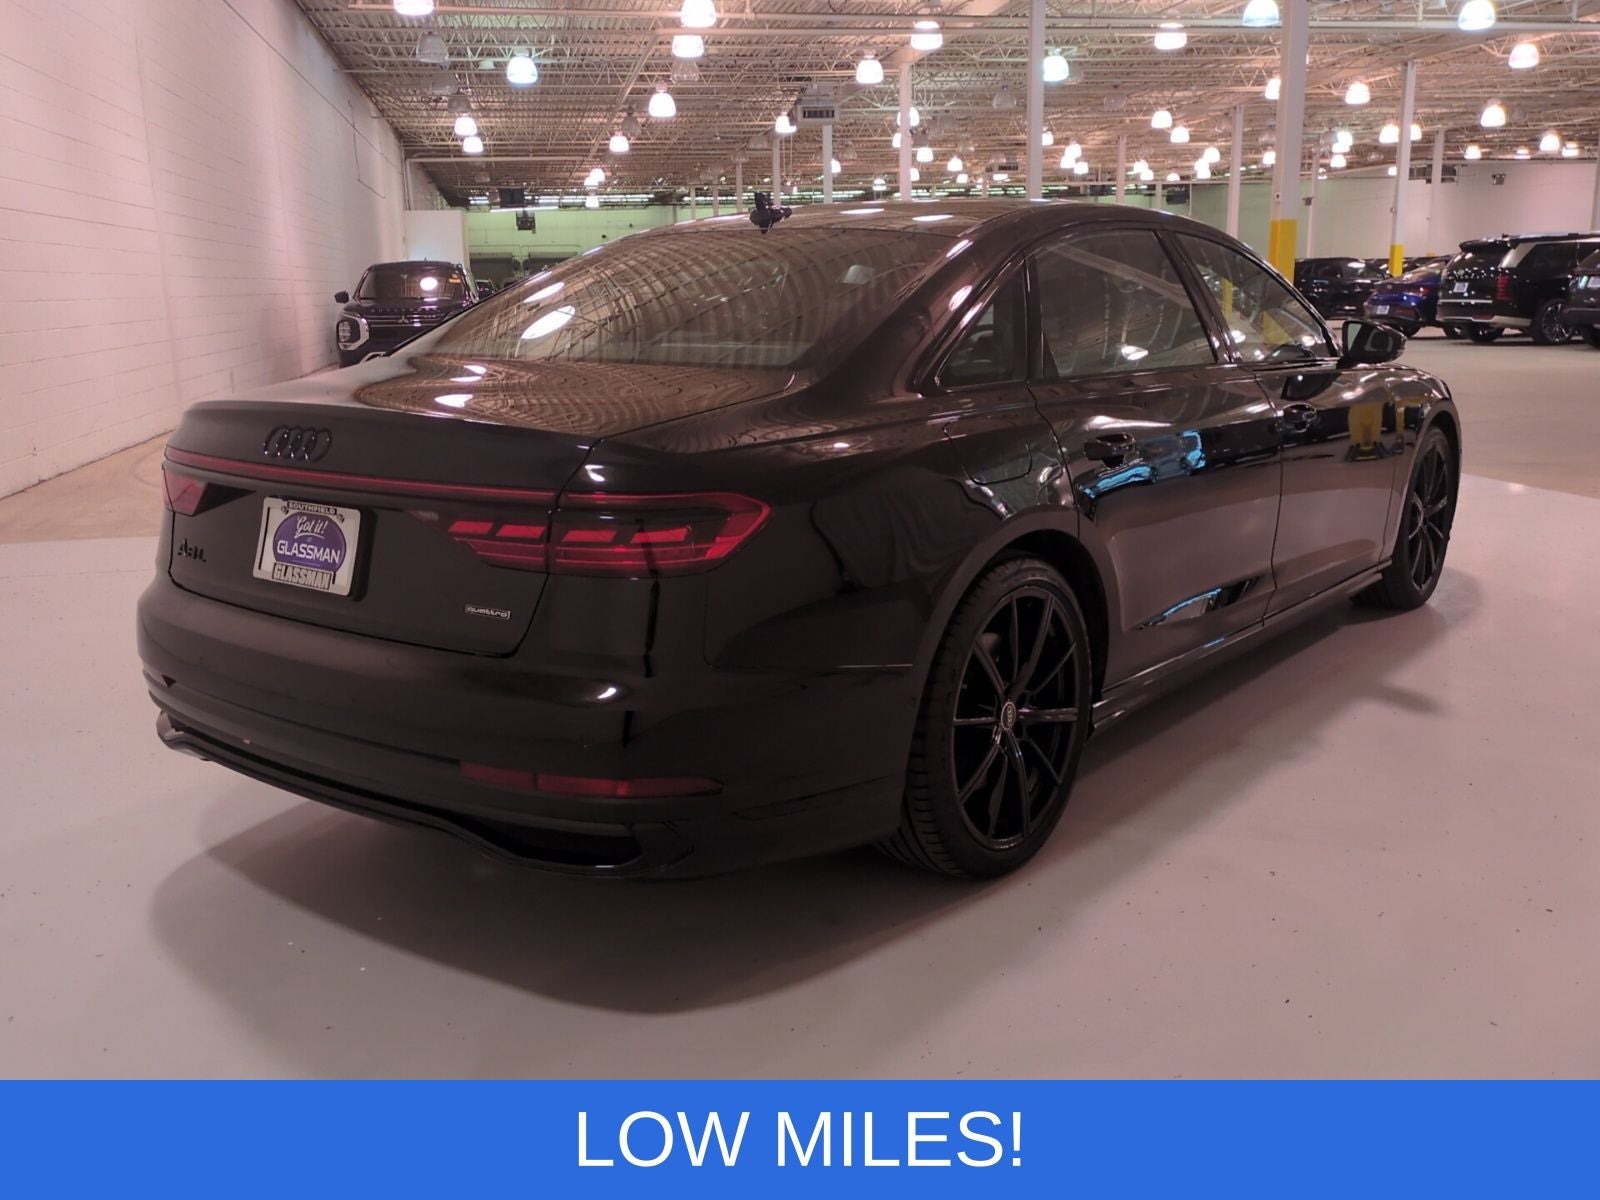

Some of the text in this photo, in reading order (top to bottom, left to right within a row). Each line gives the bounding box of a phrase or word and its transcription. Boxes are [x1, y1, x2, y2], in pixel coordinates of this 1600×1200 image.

[288, 501, 336, 514] SOUTHFIELD
[295, 515, 329, 536] Got it!
[277, 540, 341, 564] GLASSMAN
[273, 563, 331, 590] GLASSMAN
[467, 606, 507, 618] quattro
